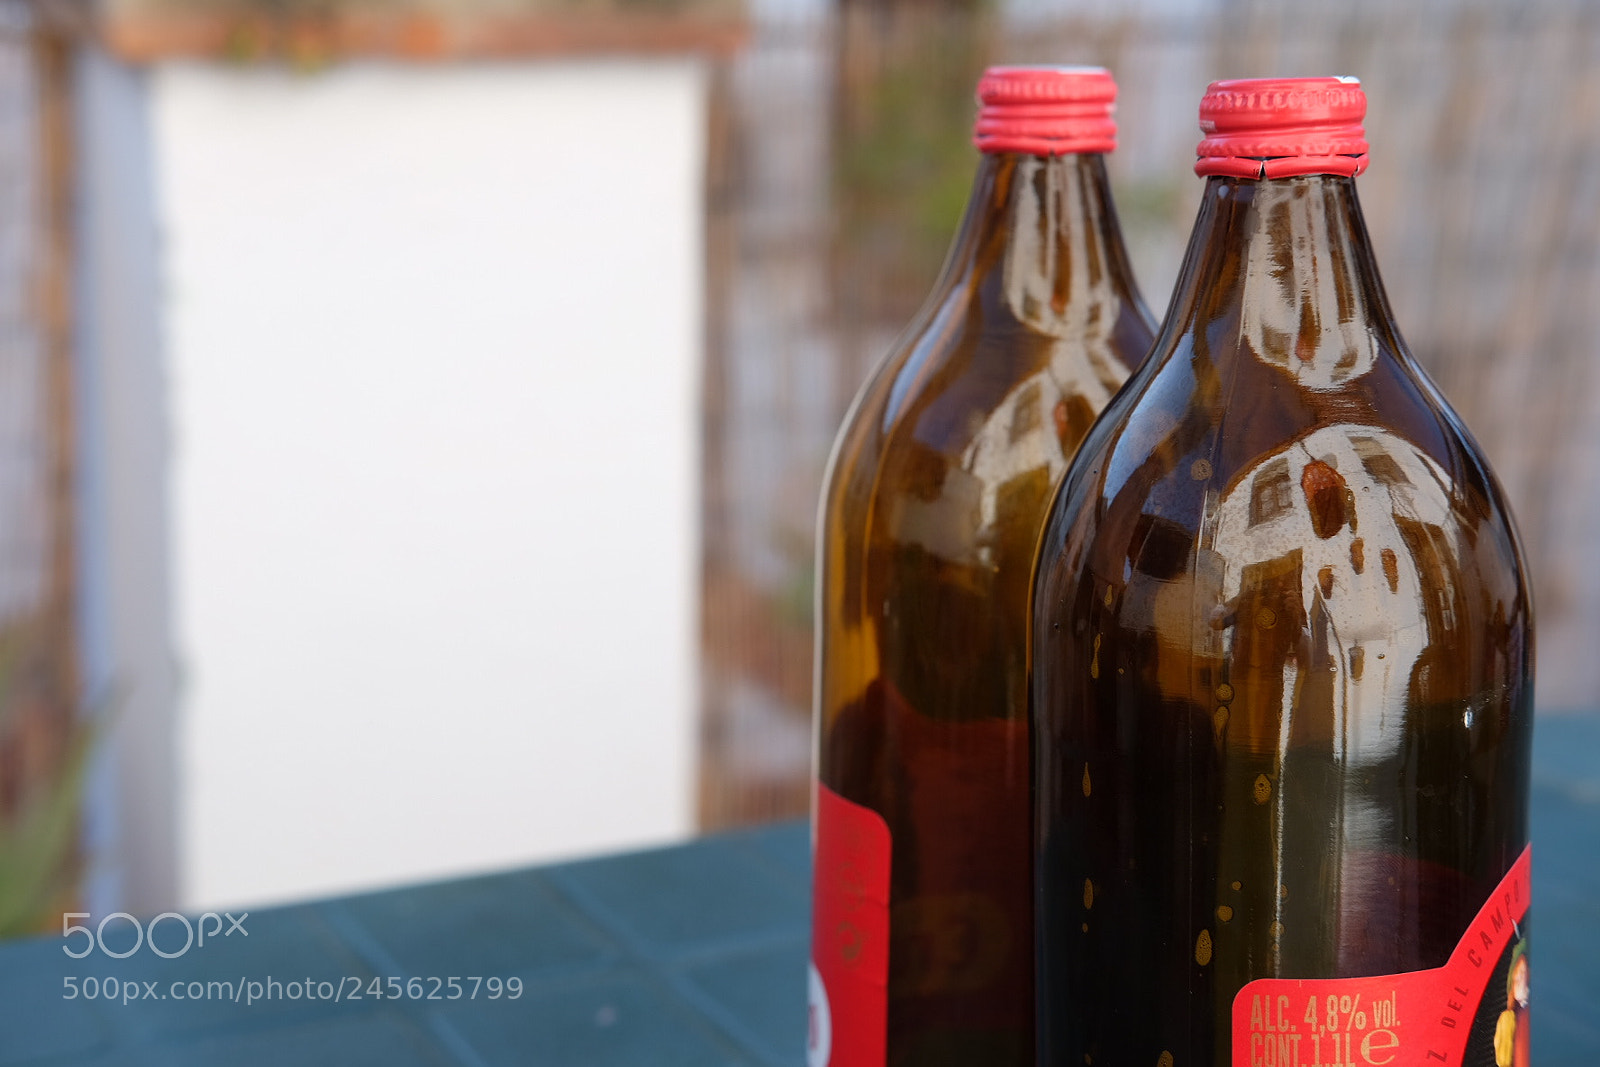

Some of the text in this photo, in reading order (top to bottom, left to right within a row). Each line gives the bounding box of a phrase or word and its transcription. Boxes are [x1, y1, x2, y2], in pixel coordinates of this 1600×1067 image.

[1440, 985, 1469, 1029] DEL
[1467, 879, 1520, 969] CAMPO
[1250, 994, 1297, 1032] ALC.
[1303, 993, 1367, 1037] 4,8%
